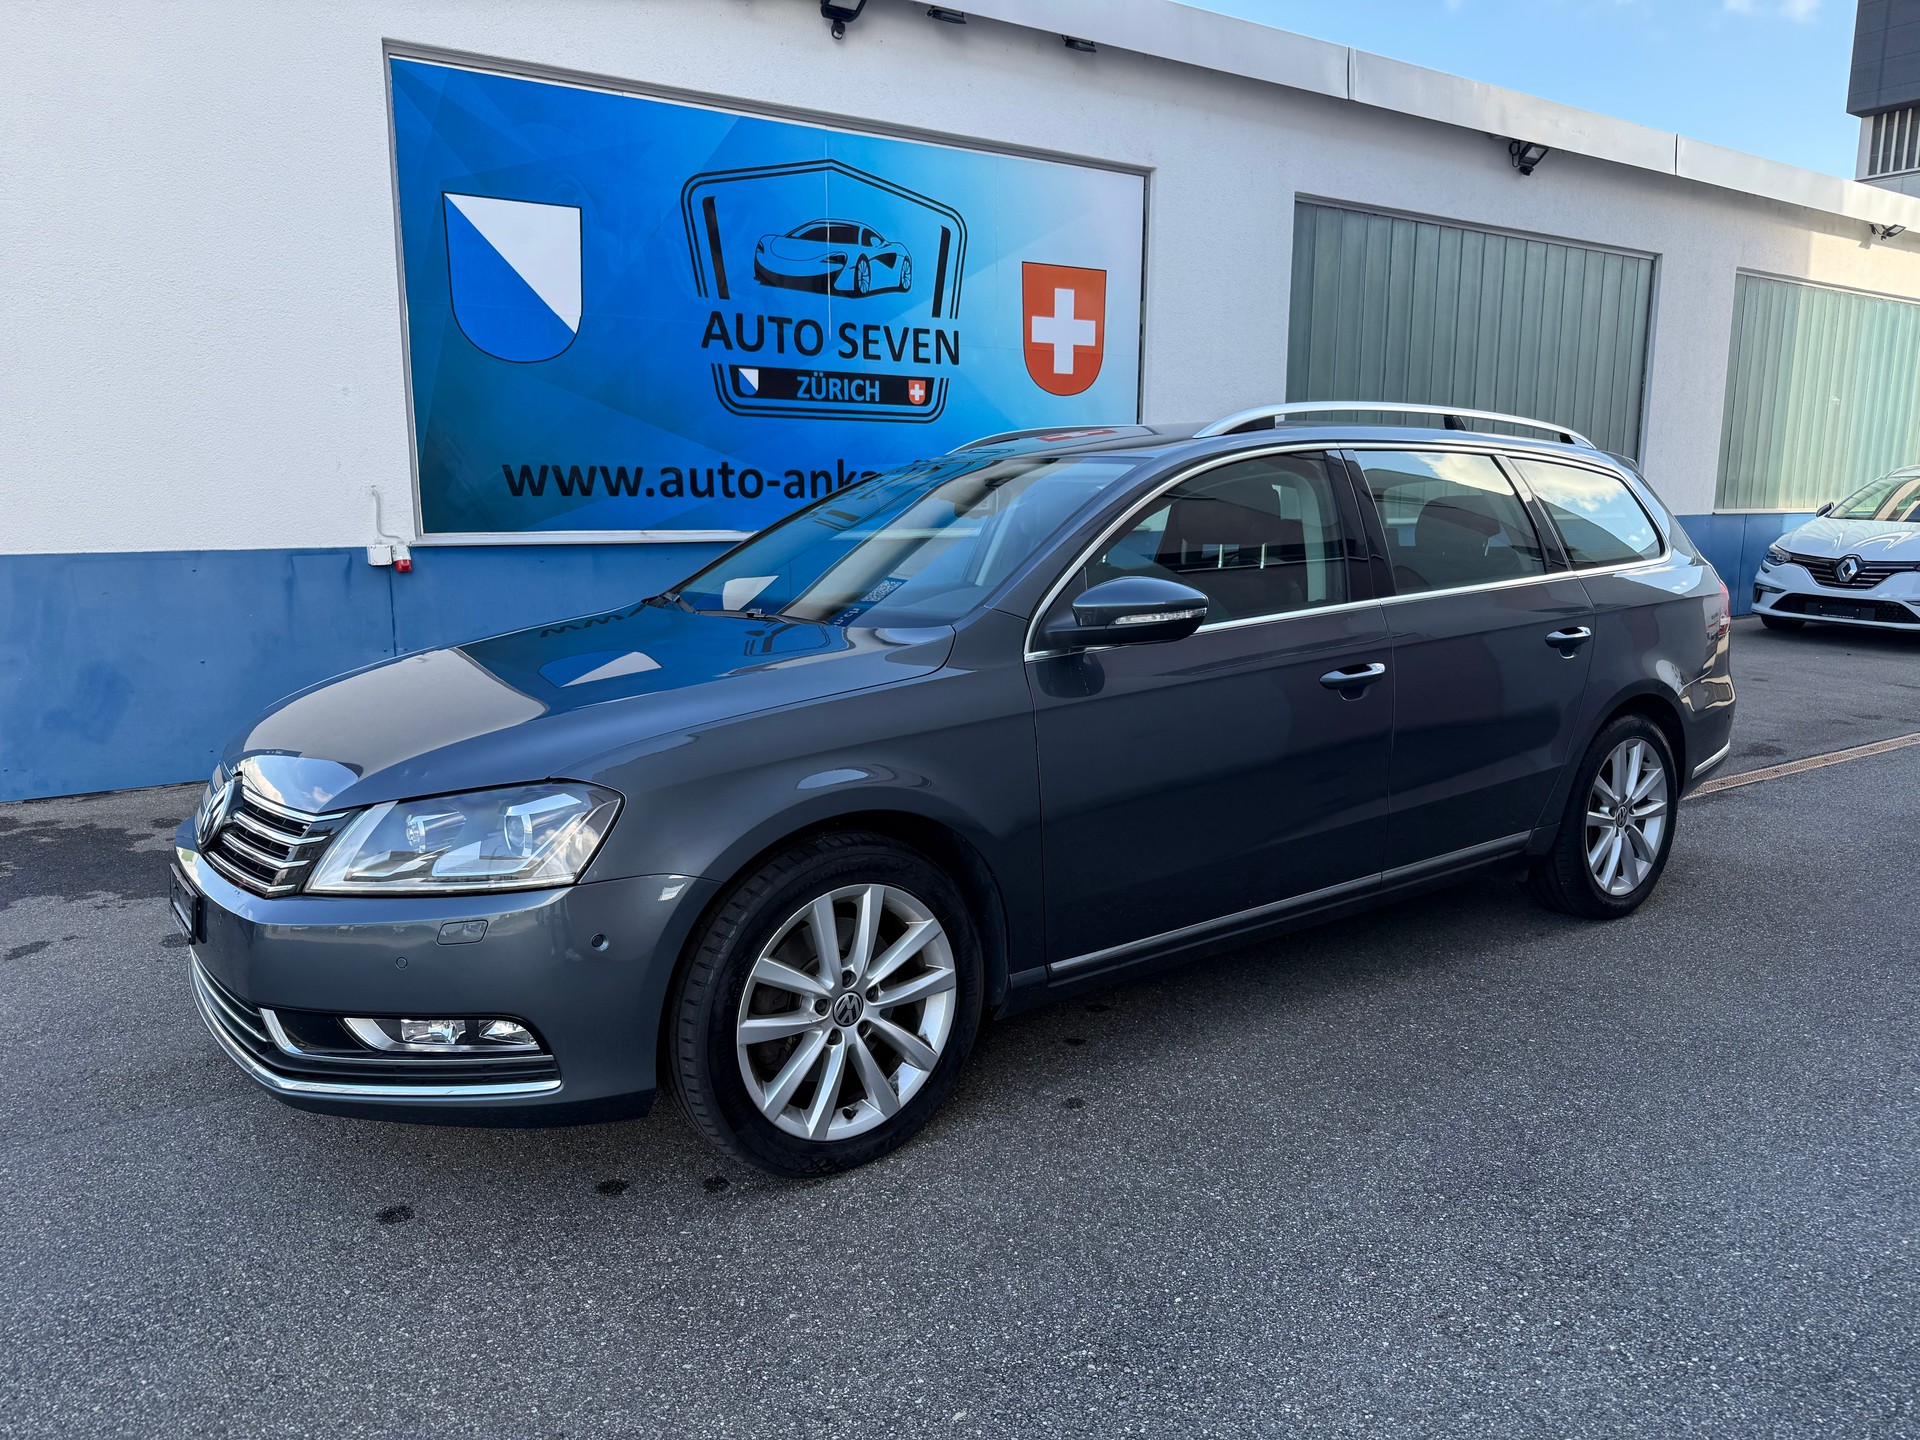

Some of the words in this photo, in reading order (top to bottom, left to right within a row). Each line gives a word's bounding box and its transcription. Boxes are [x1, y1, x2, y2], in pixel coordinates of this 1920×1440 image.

[701, 310, 824, 357] AUTO
[837, 322, 960, 366] SEVEN
[796, 371, 880, 402] ZÜRICH
[502, 458, 881, 499] www.auto-ank
